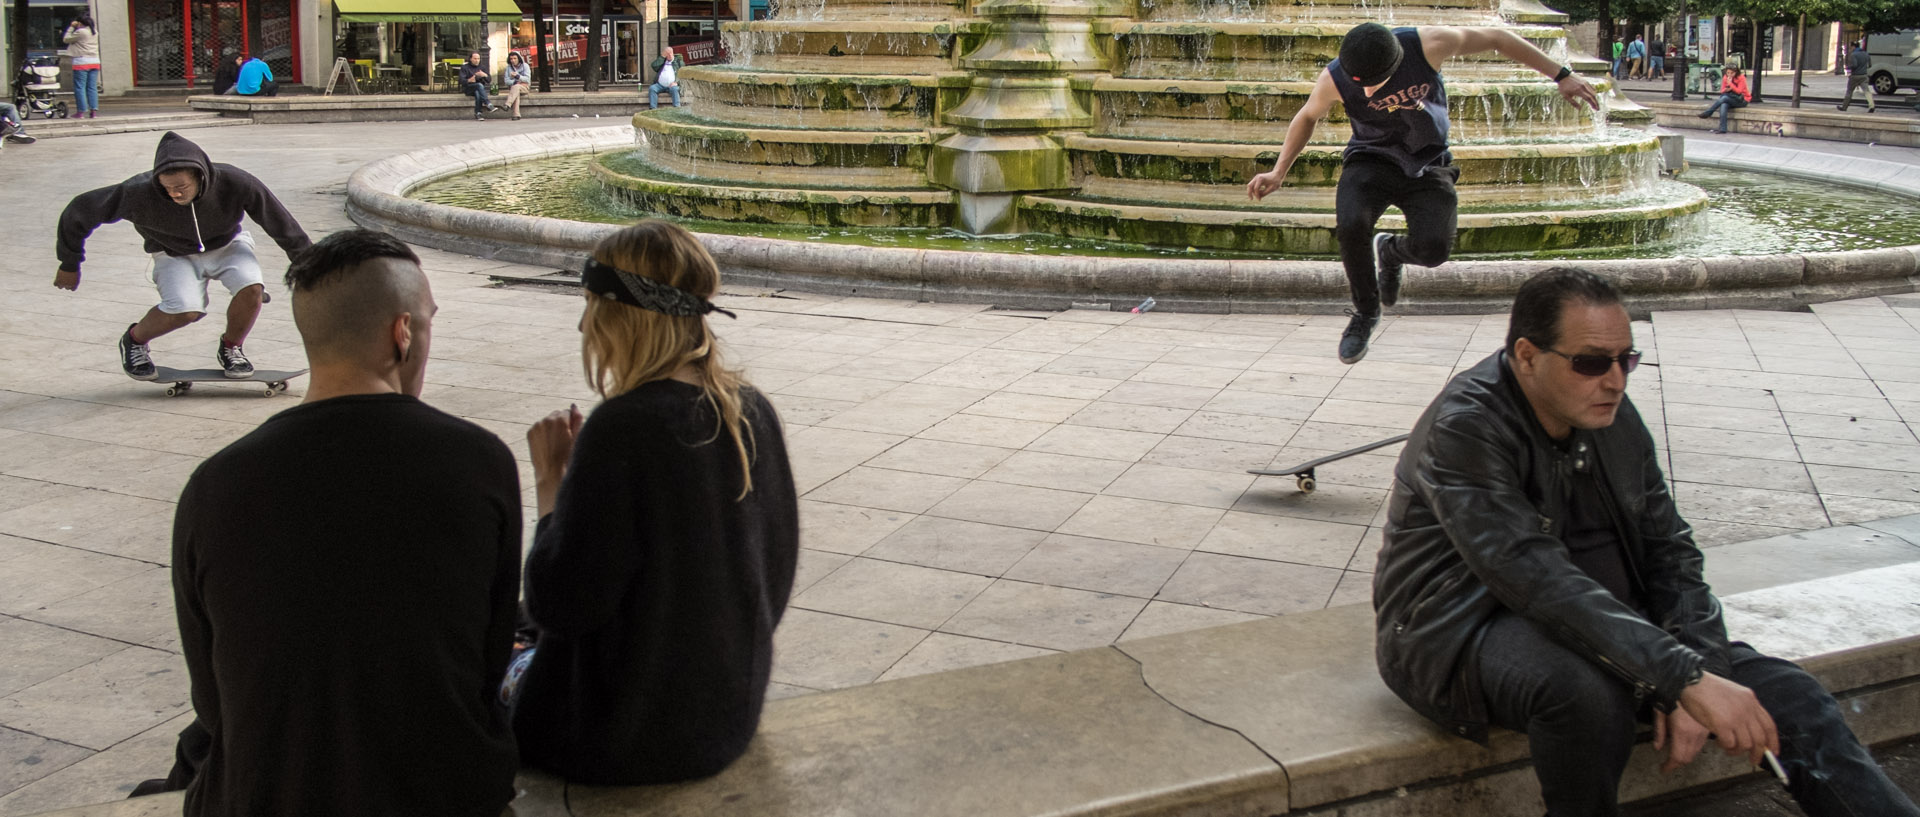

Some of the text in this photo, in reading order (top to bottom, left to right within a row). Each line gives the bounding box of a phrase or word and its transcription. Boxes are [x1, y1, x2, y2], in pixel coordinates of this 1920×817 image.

[411, 15, 435, 23] pasta
[565, 24, 590, 36] Scho
[686, 42, 714, 51] LIQUIDATIO
[687, 47, 715, 61] TOTAL
